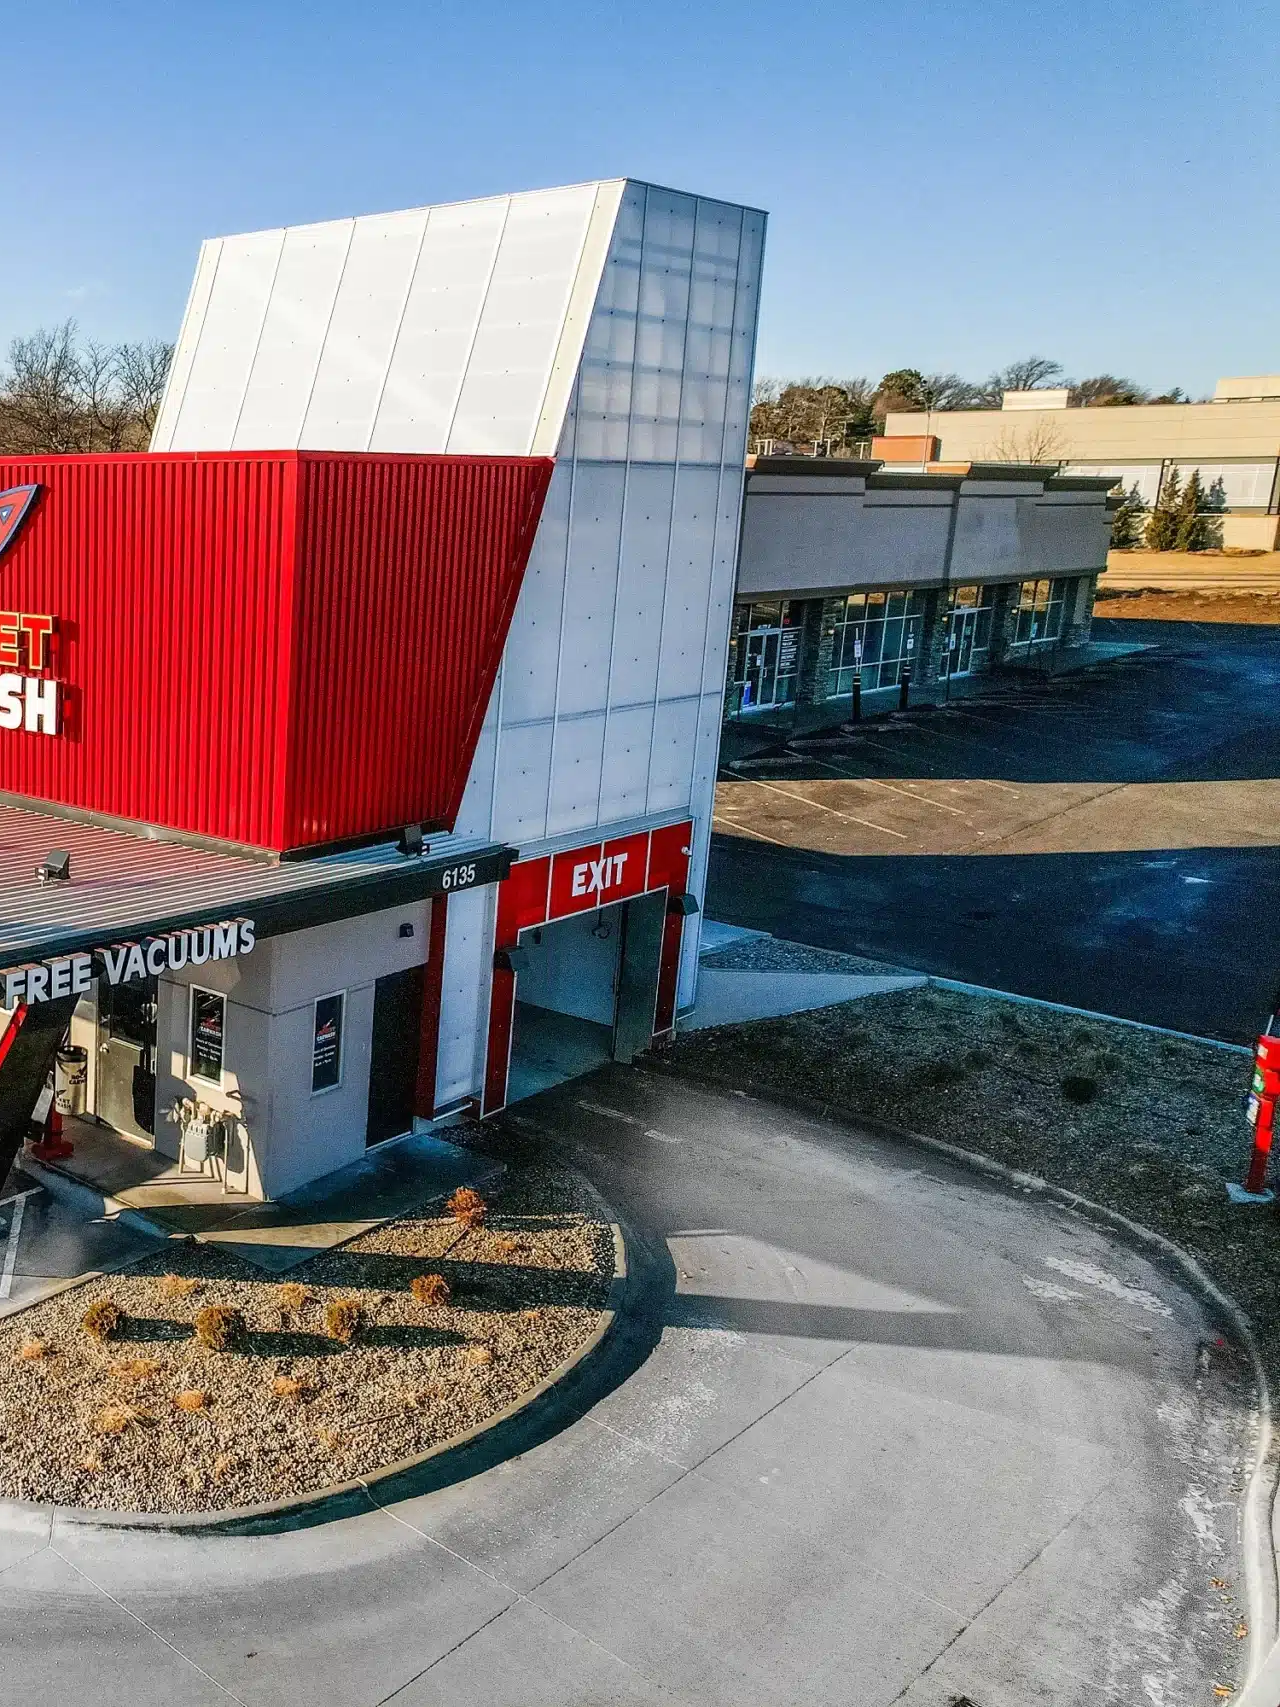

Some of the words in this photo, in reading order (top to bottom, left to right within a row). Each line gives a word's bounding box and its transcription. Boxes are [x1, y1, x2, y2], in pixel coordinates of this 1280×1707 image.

[442, 863, 476, 889] 6135
[572, 853, 629, 897] EXIT
[5, 953, 92, 1010] FREE
[103, 918, 256, 986] VACUUMS
